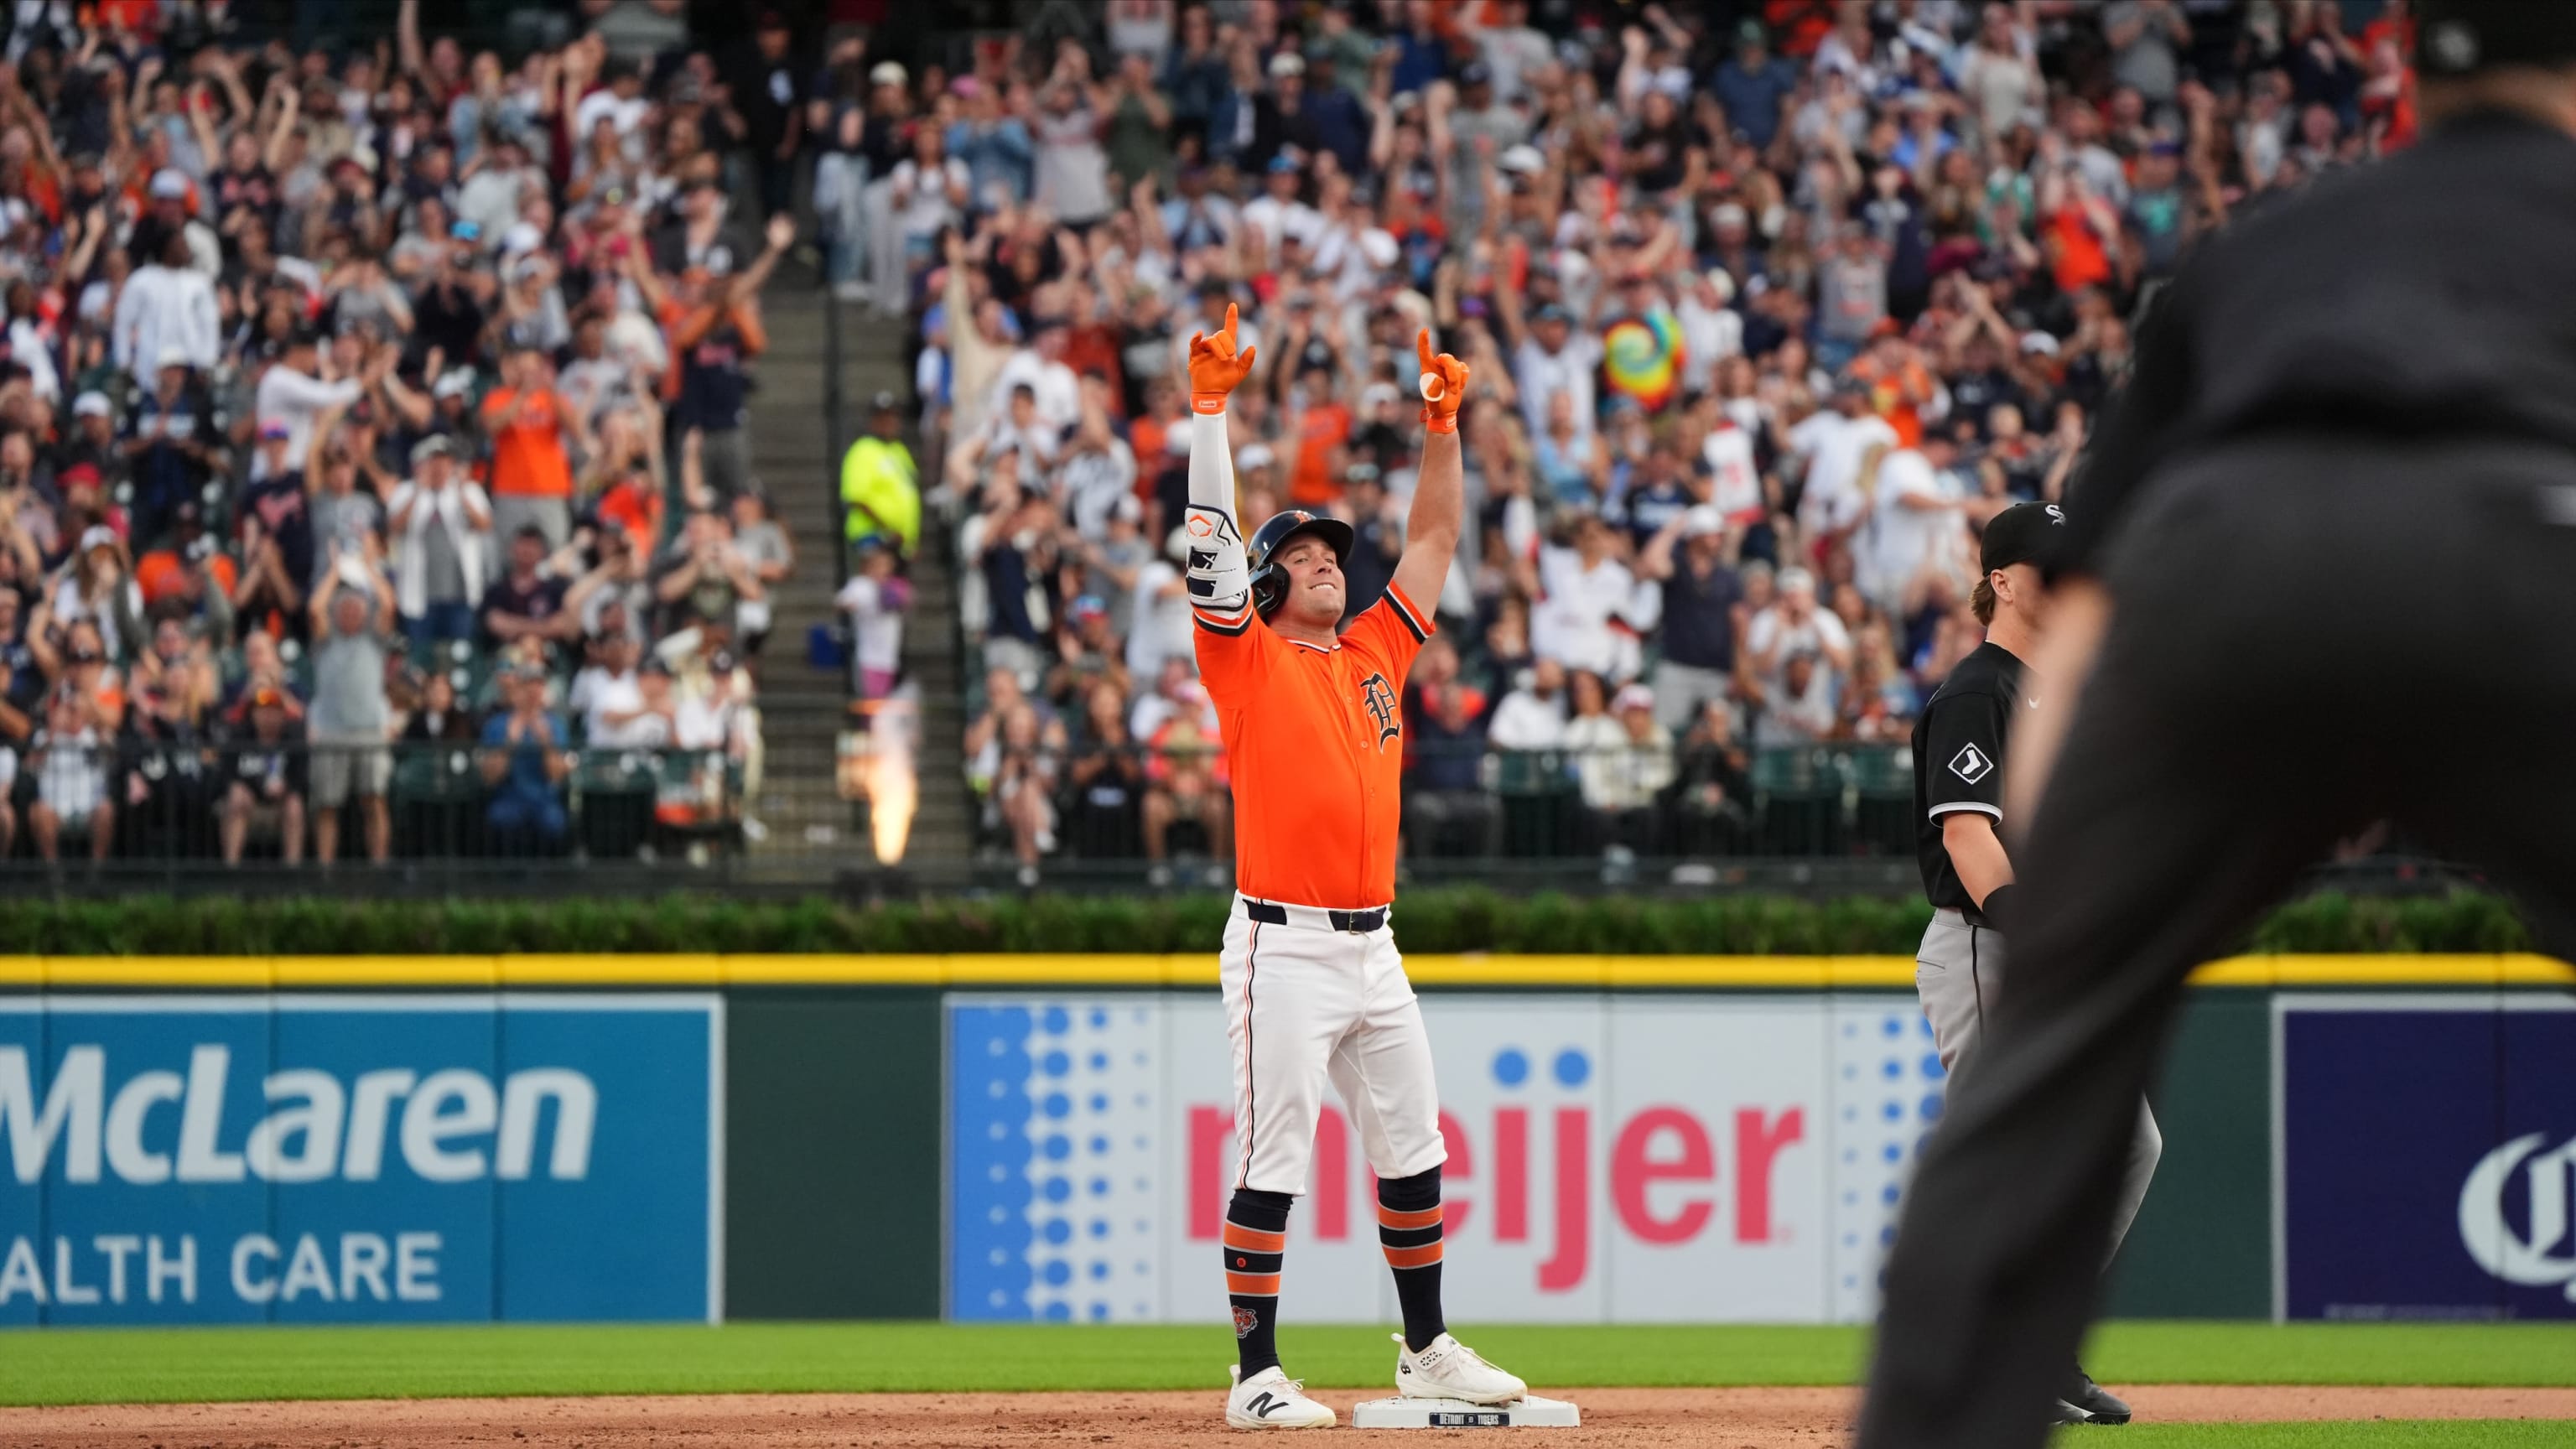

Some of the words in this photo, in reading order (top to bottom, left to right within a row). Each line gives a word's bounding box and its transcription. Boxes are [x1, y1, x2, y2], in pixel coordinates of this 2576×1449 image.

[1360, 672, 1401, 753] D
[0, 1042, 598, 1183] McLaren
[0, 1235, 197, 1305] ALTH
[230, 1232, 443, 1301] CARE
[1247, 1392, 1289, 1418] N
[1439, 1414, 1464, 1425] DETROIT
[1478, 1414, 1499, 1426] TIGERS
